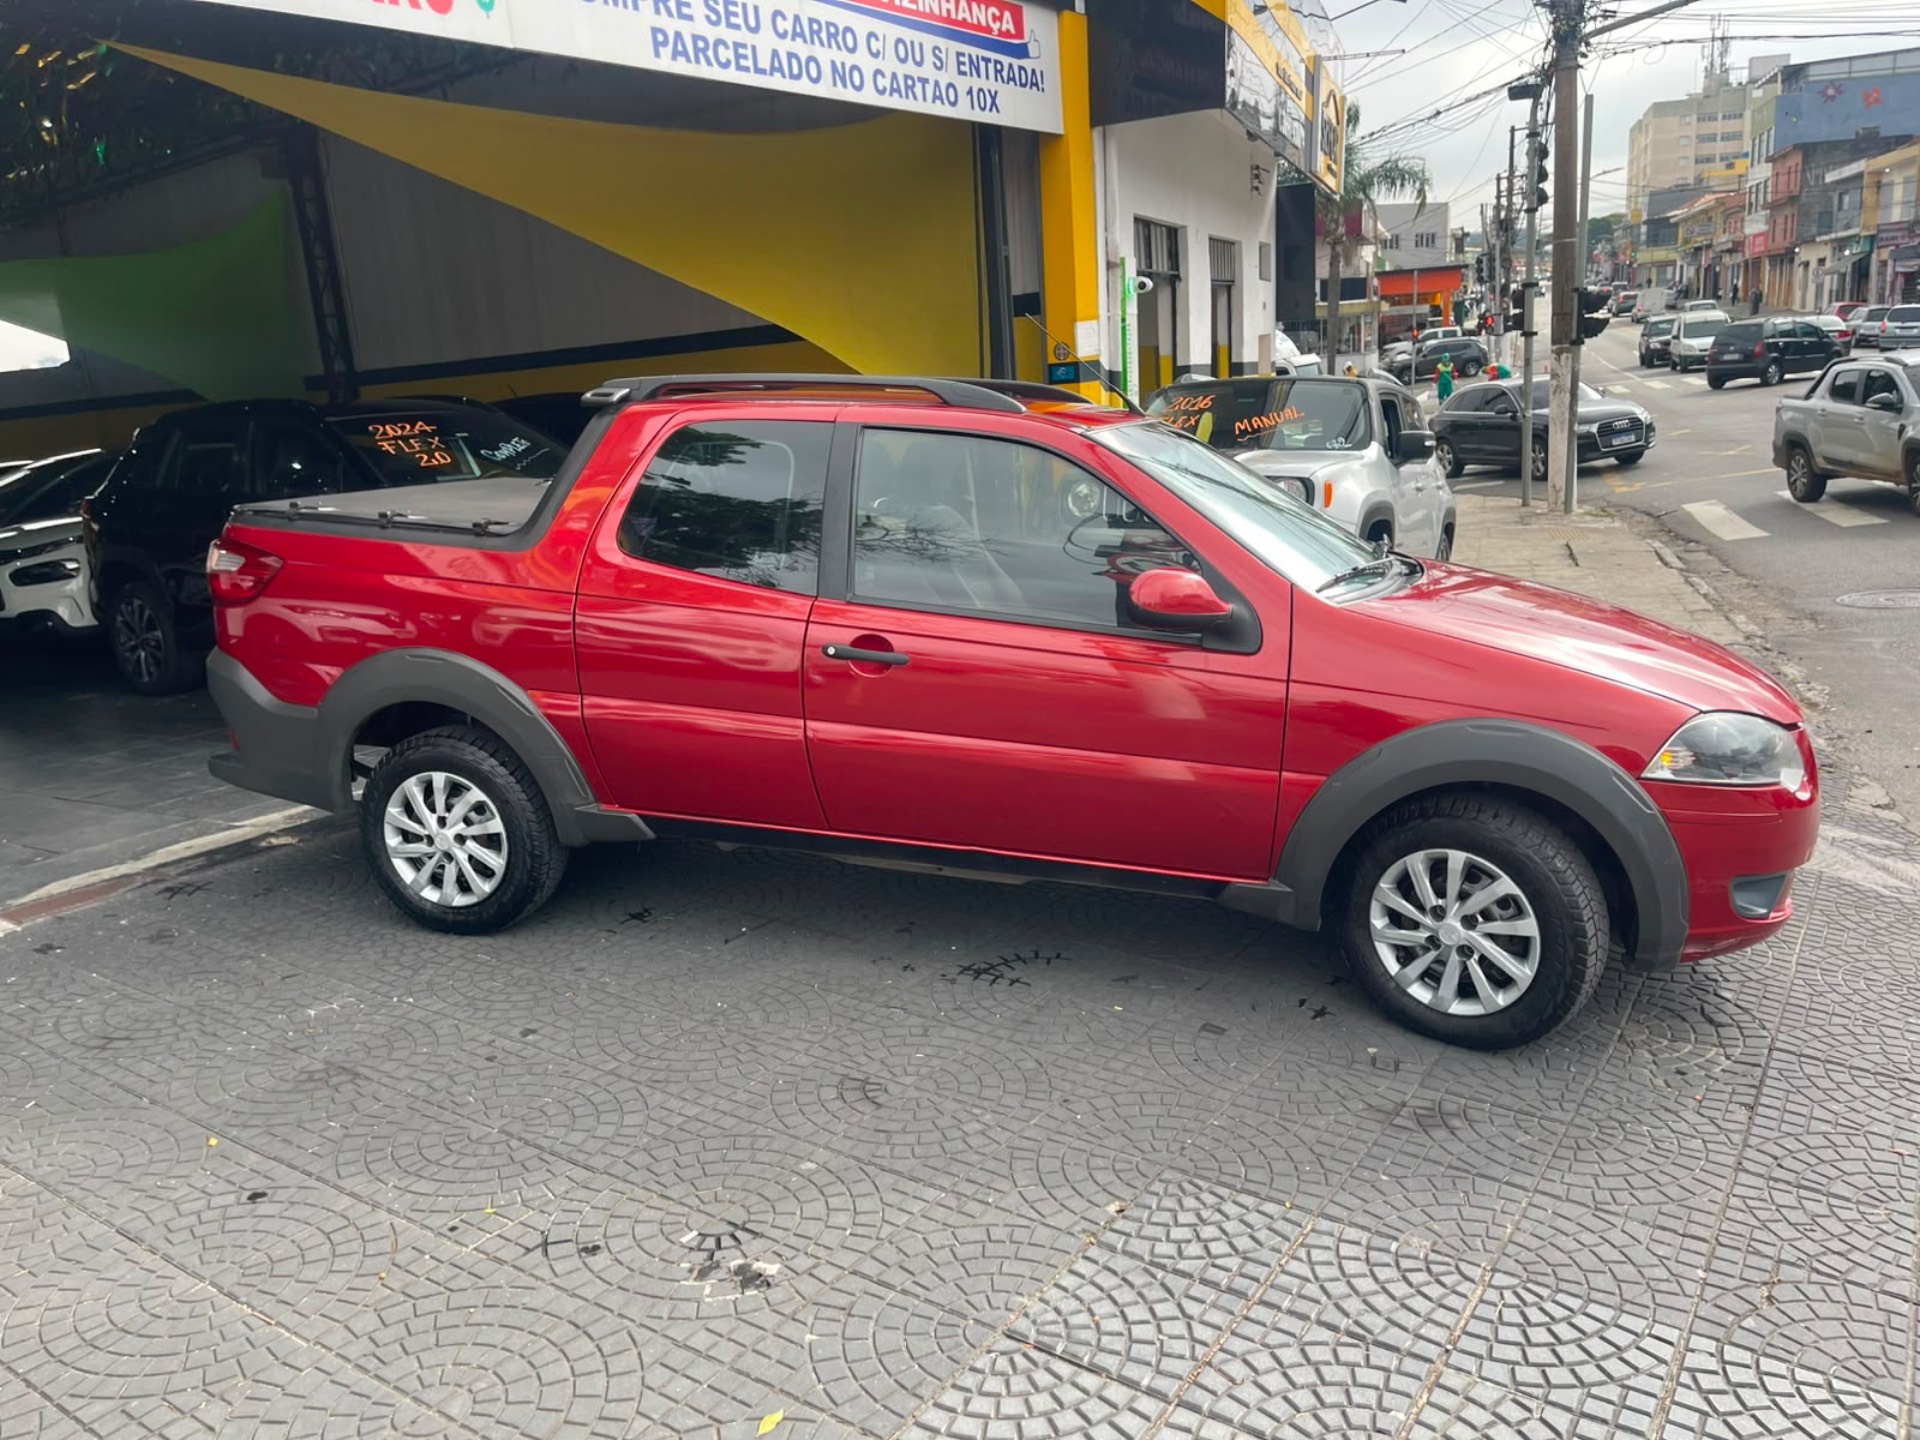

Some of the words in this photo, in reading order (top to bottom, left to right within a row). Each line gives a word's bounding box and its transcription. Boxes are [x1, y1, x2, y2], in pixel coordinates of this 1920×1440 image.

[881, 0, 1017, 35] INHANÇA
[702, 0, 761, 34] SEU
[770, 9, 858, 55] CARRO
[865, 31, 886, 60] C/
[893, 38, 925, 68] OU
[932, 46, 949, 72] S/
[955, 51, 1046, 93] ENTRADA!
[650, 26, 822, 84] PARCELADO
[831, 59, 864, 92] NO
[872, 68, 959, 107] CARTAO
[966, 86, 1001, 114] 10X
[1163, 394, 1216, 411] 2016
[368, 421, 437, 439] 2024
[1234, 405, 1305, 435] MANUAL
[377, 436, 446, 455] FLEX
